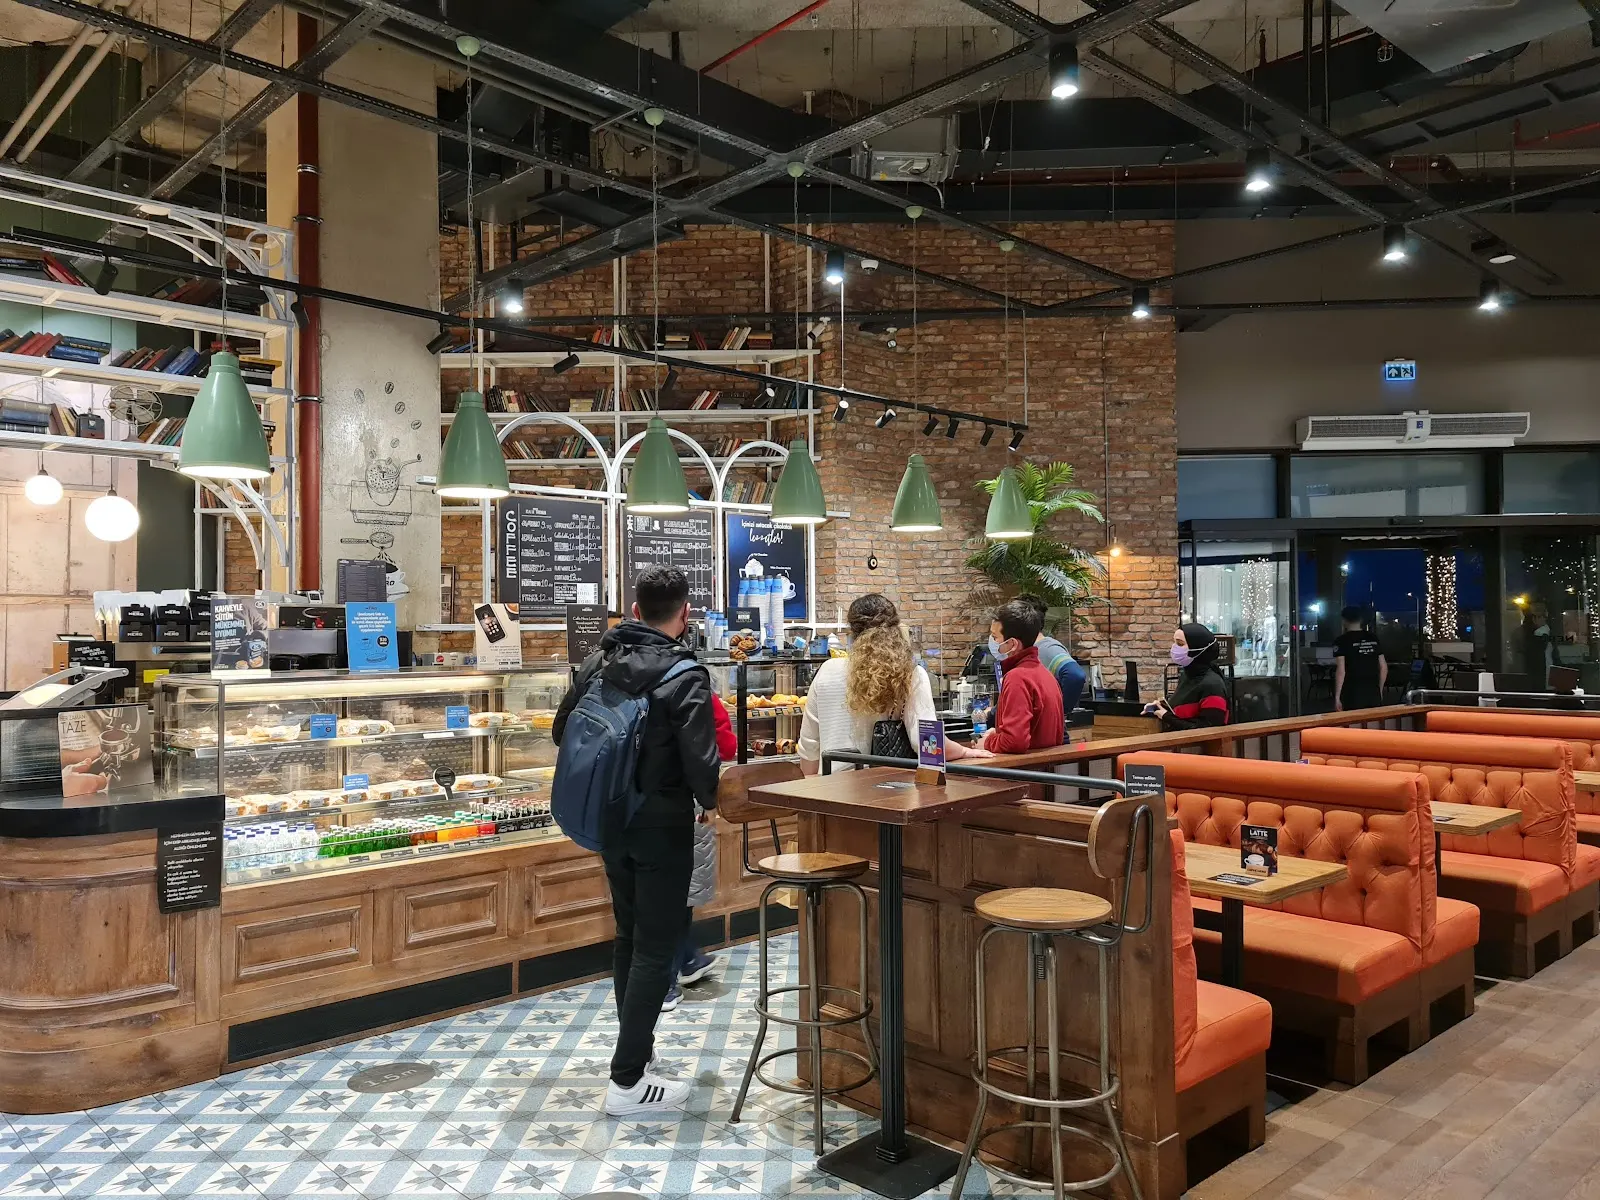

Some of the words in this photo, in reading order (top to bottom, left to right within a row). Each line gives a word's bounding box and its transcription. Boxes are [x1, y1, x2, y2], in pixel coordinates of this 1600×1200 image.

[626, 515, 634, 530] TEA
[505, 510, 517, 579] COFFEE
[214, 604, 243, 613] KAHVEYLE
[215, 612, 234, 621] SÜTÜN
[61, 720, 87, 734] TAZE
[1249, 829, 1268, 837] LATTE
